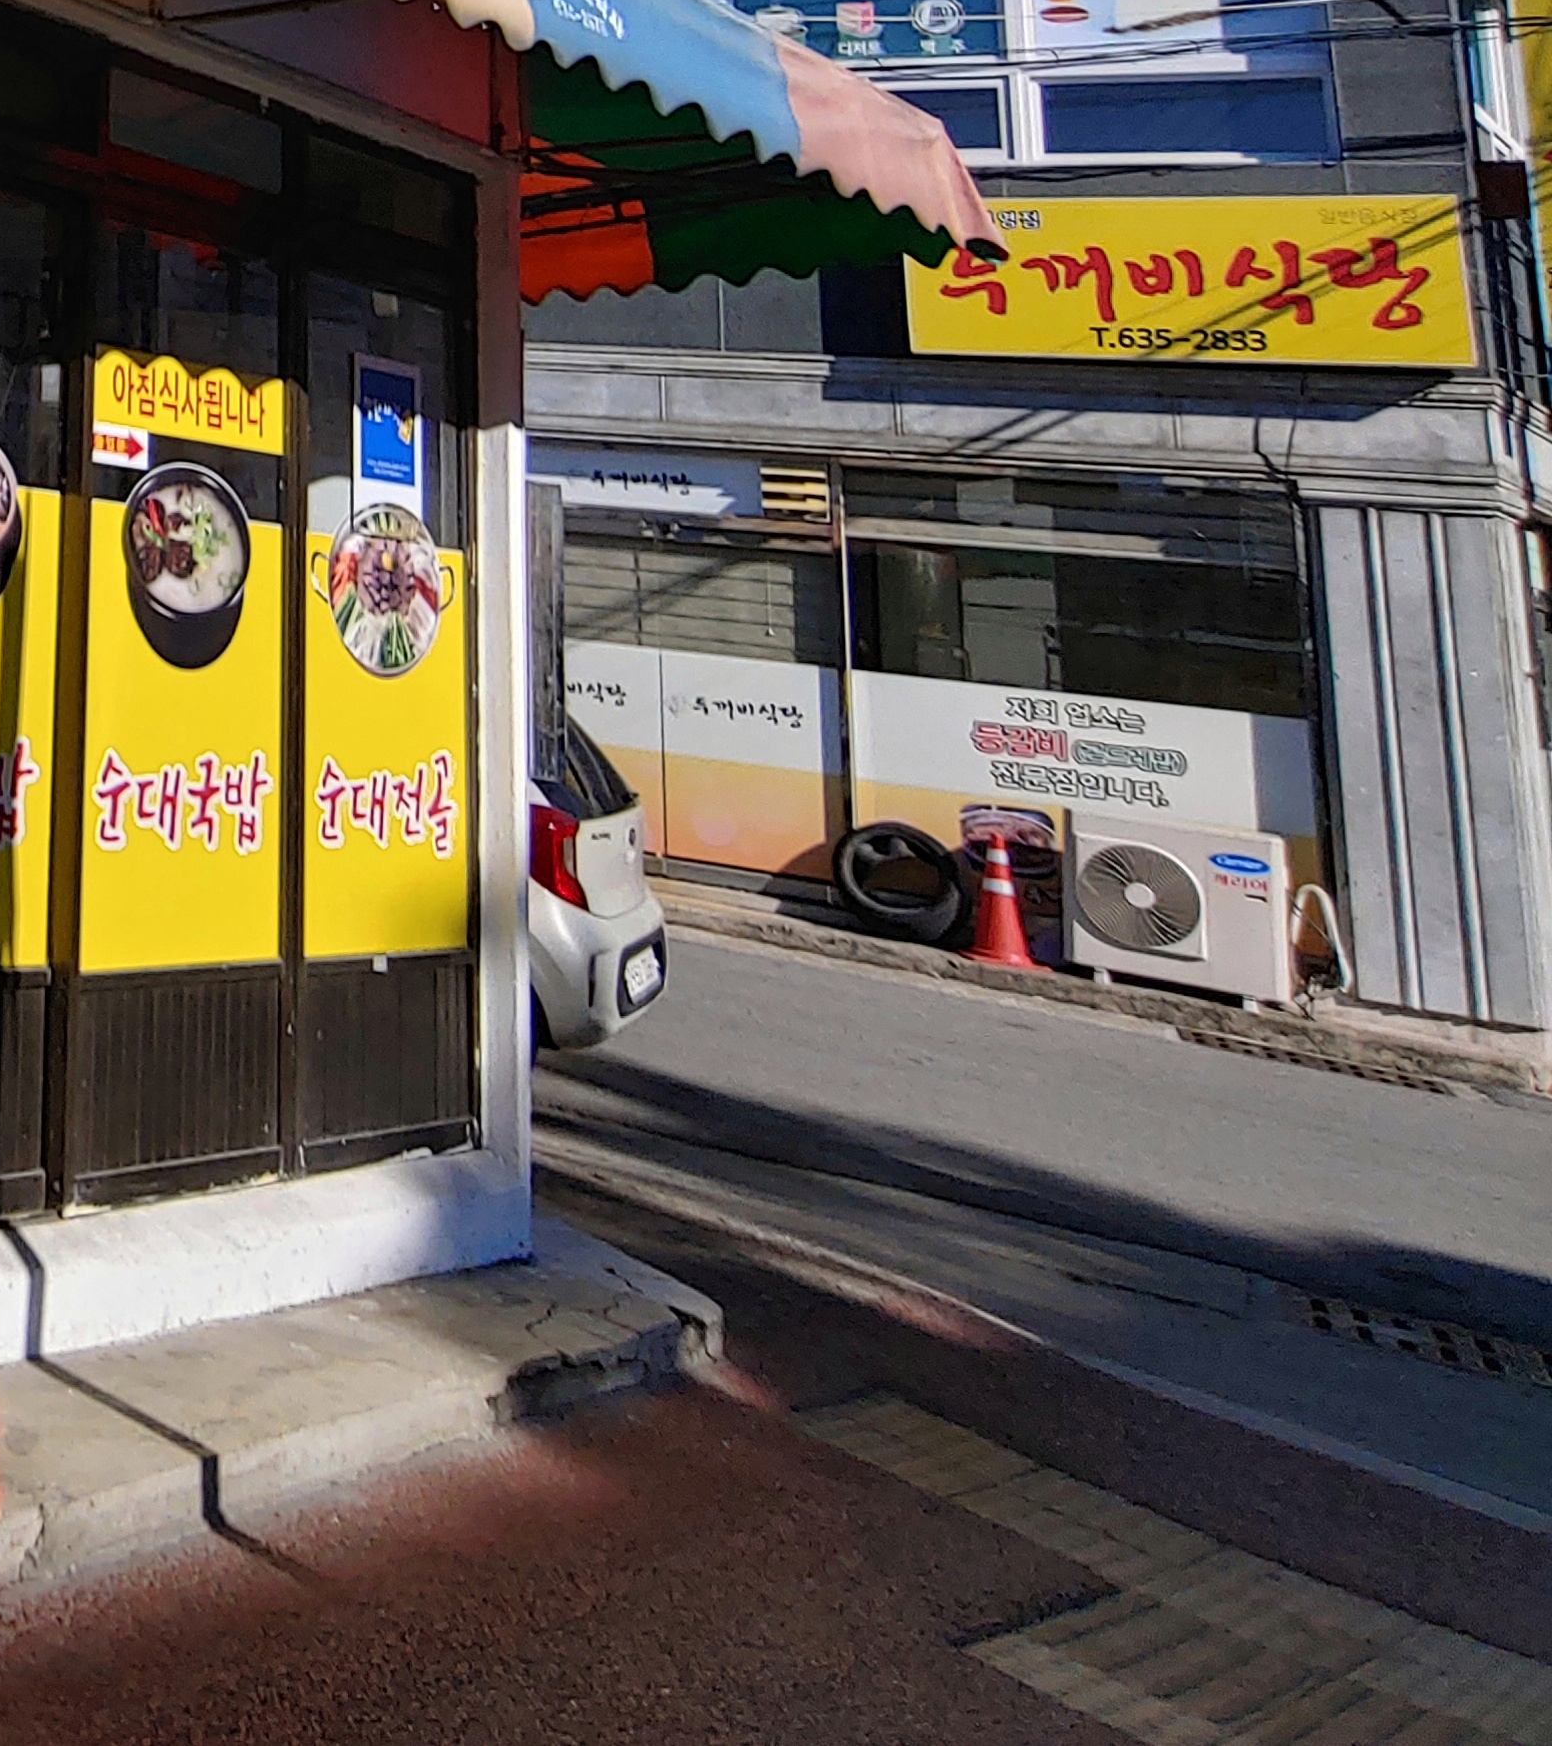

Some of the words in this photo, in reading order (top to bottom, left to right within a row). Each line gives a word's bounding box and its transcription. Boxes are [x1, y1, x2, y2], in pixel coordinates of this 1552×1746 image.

[986, 209, 1041, 230] 영점
[939, 236, 1429, 331] 두꺼비식당
[1089, 325, 1269, 353] T.635-2833
[112, 360, 266, 439] 아침식사됩니다
[692, 695, 803, 729] 두꺼비식당
[1004, 696, 1060, 725] 저희
[1064, 701, 1146, 735] 업소는
[970, 720, 1069, 763] 등갈비
[92, 746, 274, 856] 순대국밥
[315, 749, 456, 860] 순대전골
[989, 759, 1170, 807] 전문점입니다.
